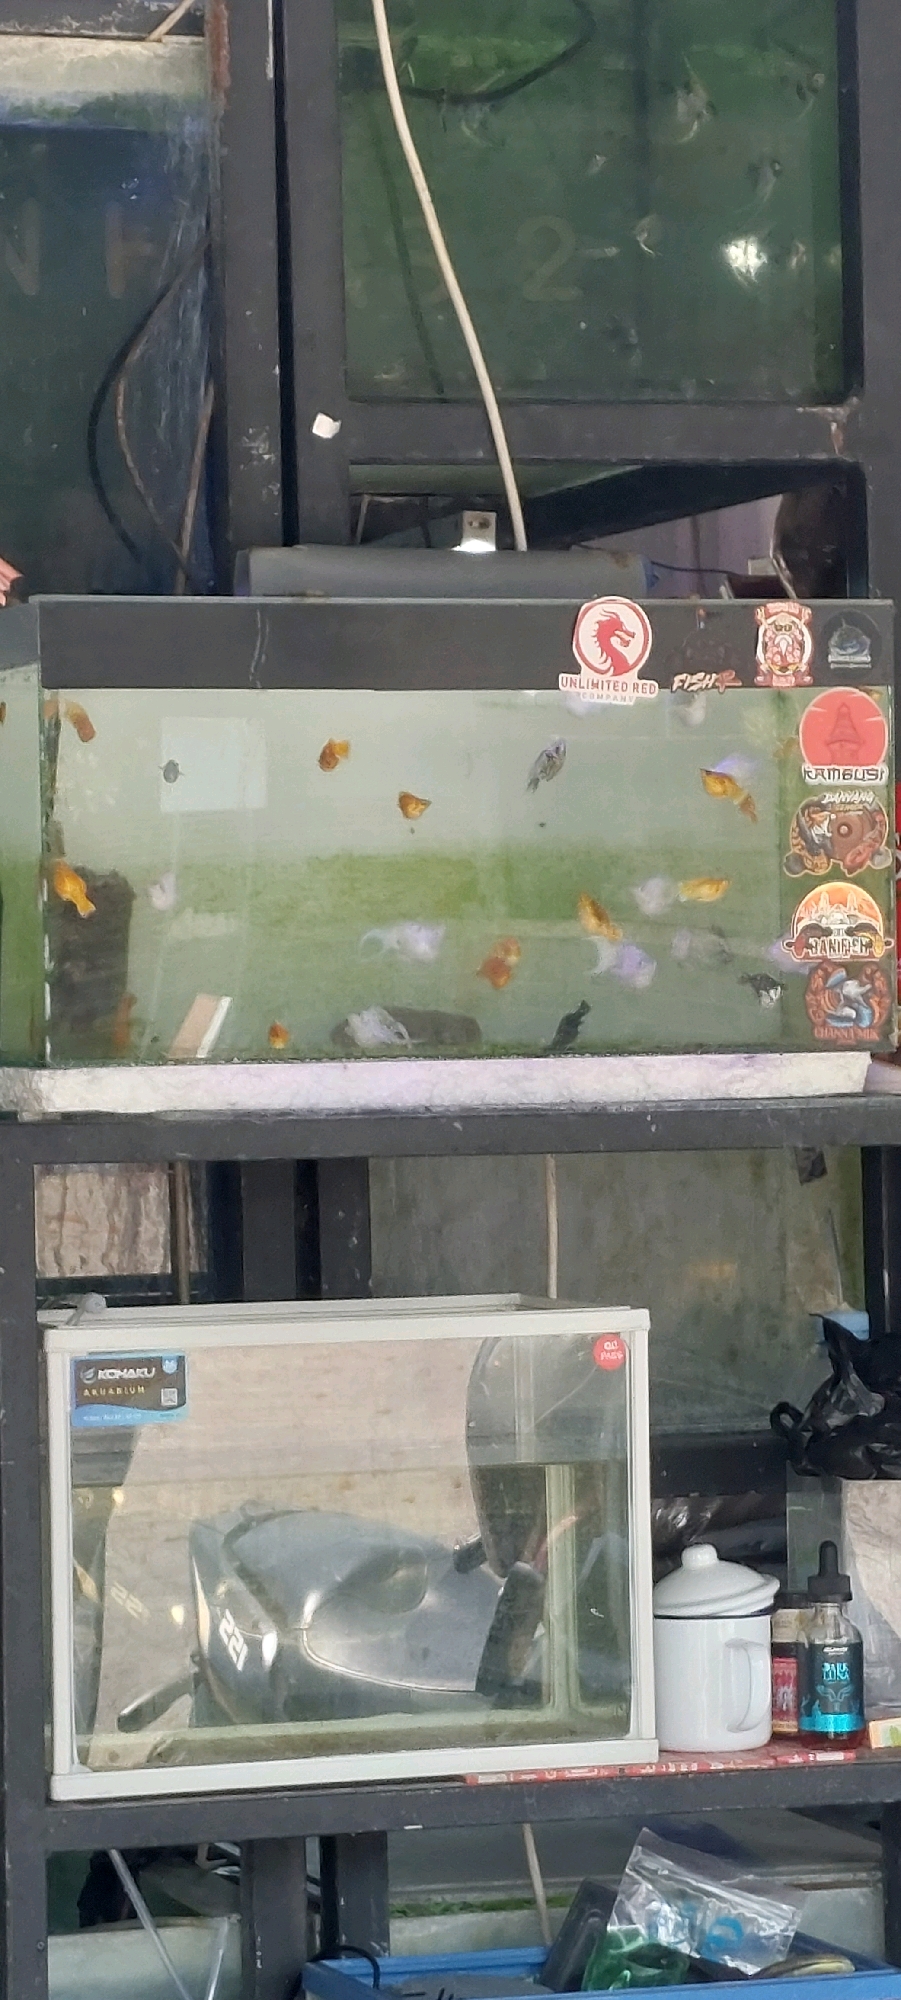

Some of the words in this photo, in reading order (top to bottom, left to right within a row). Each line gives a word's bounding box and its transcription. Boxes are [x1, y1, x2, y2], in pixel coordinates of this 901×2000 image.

[561, 676, 628, 692] UNLIMITED
[632, 682, 656, 695] RED
[581, 692, 634, 703] COMPANY
